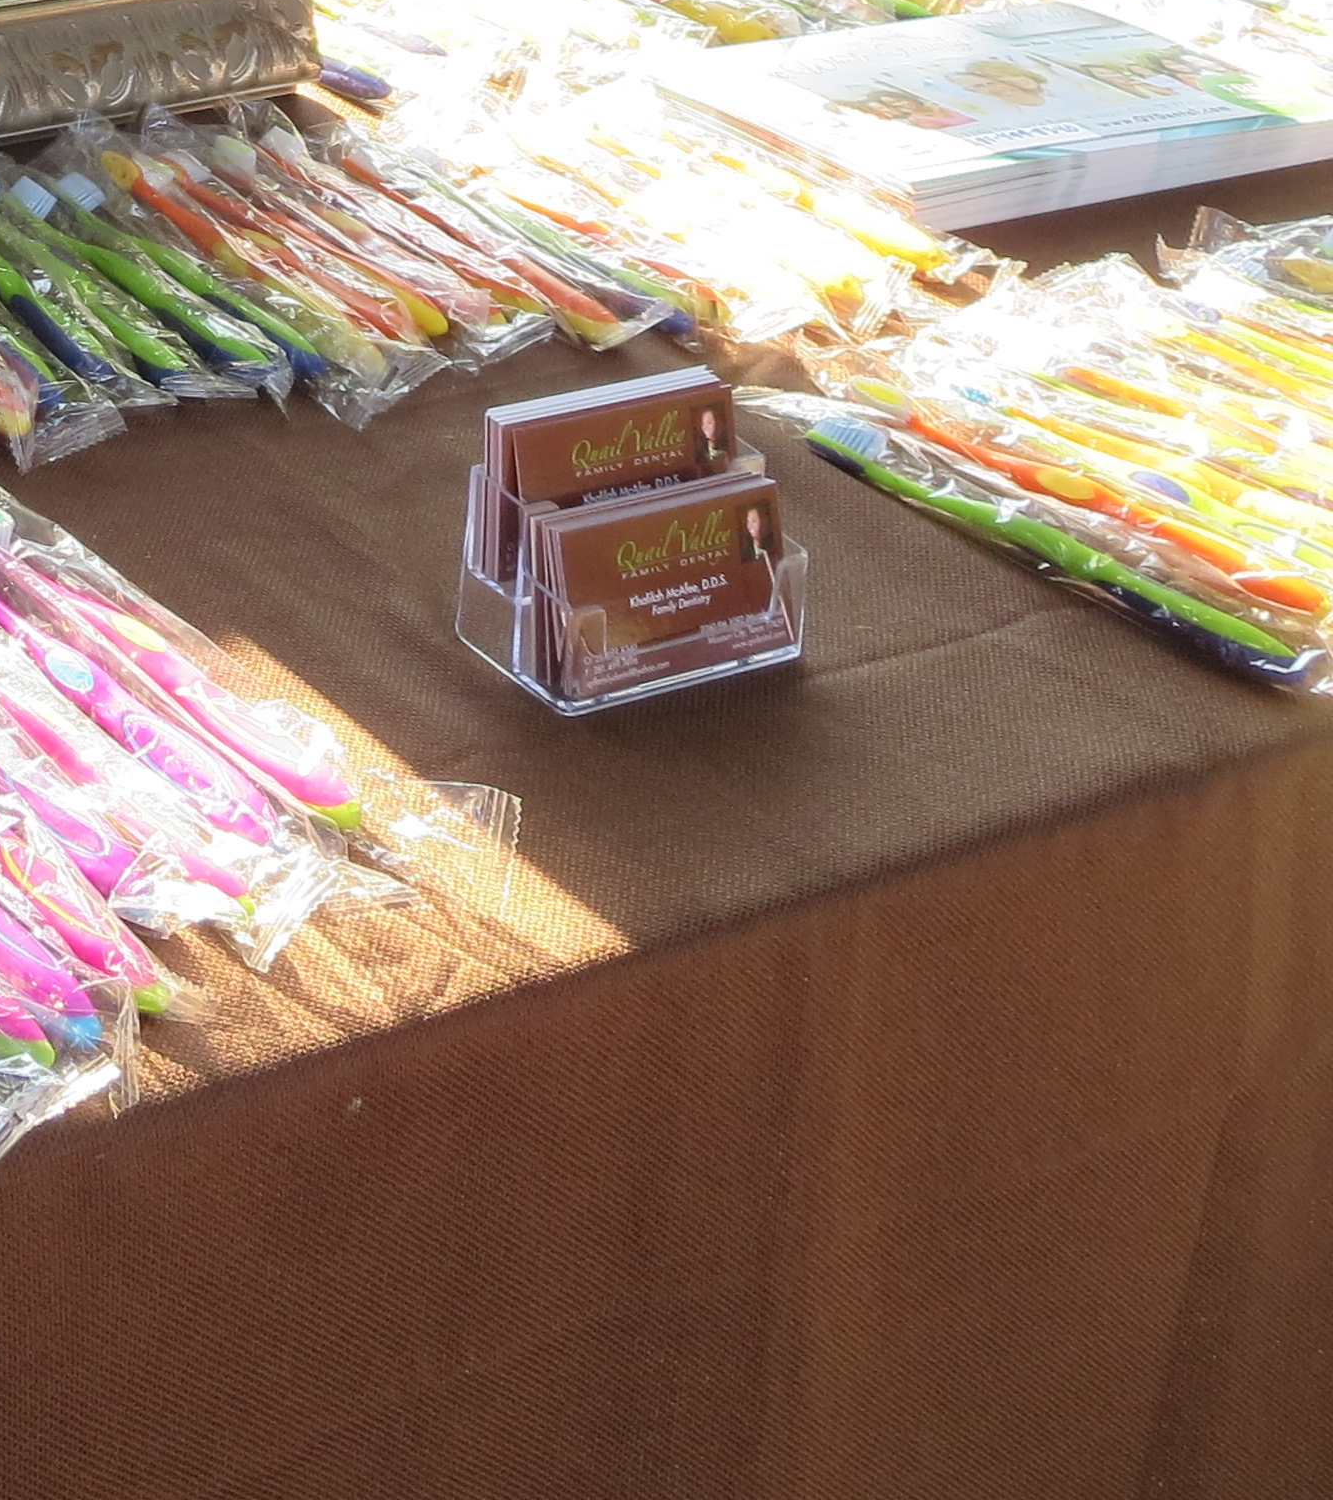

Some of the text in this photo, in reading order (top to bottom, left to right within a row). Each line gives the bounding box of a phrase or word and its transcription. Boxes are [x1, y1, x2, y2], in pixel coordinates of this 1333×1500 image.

[572, 419, 633, 469] Quail
[576, 449, 684, 478] FAMILY DENTAL
[617, 520, 678, 572] Quail
[622, 548, 730, 580] FAMILY DENTAL
